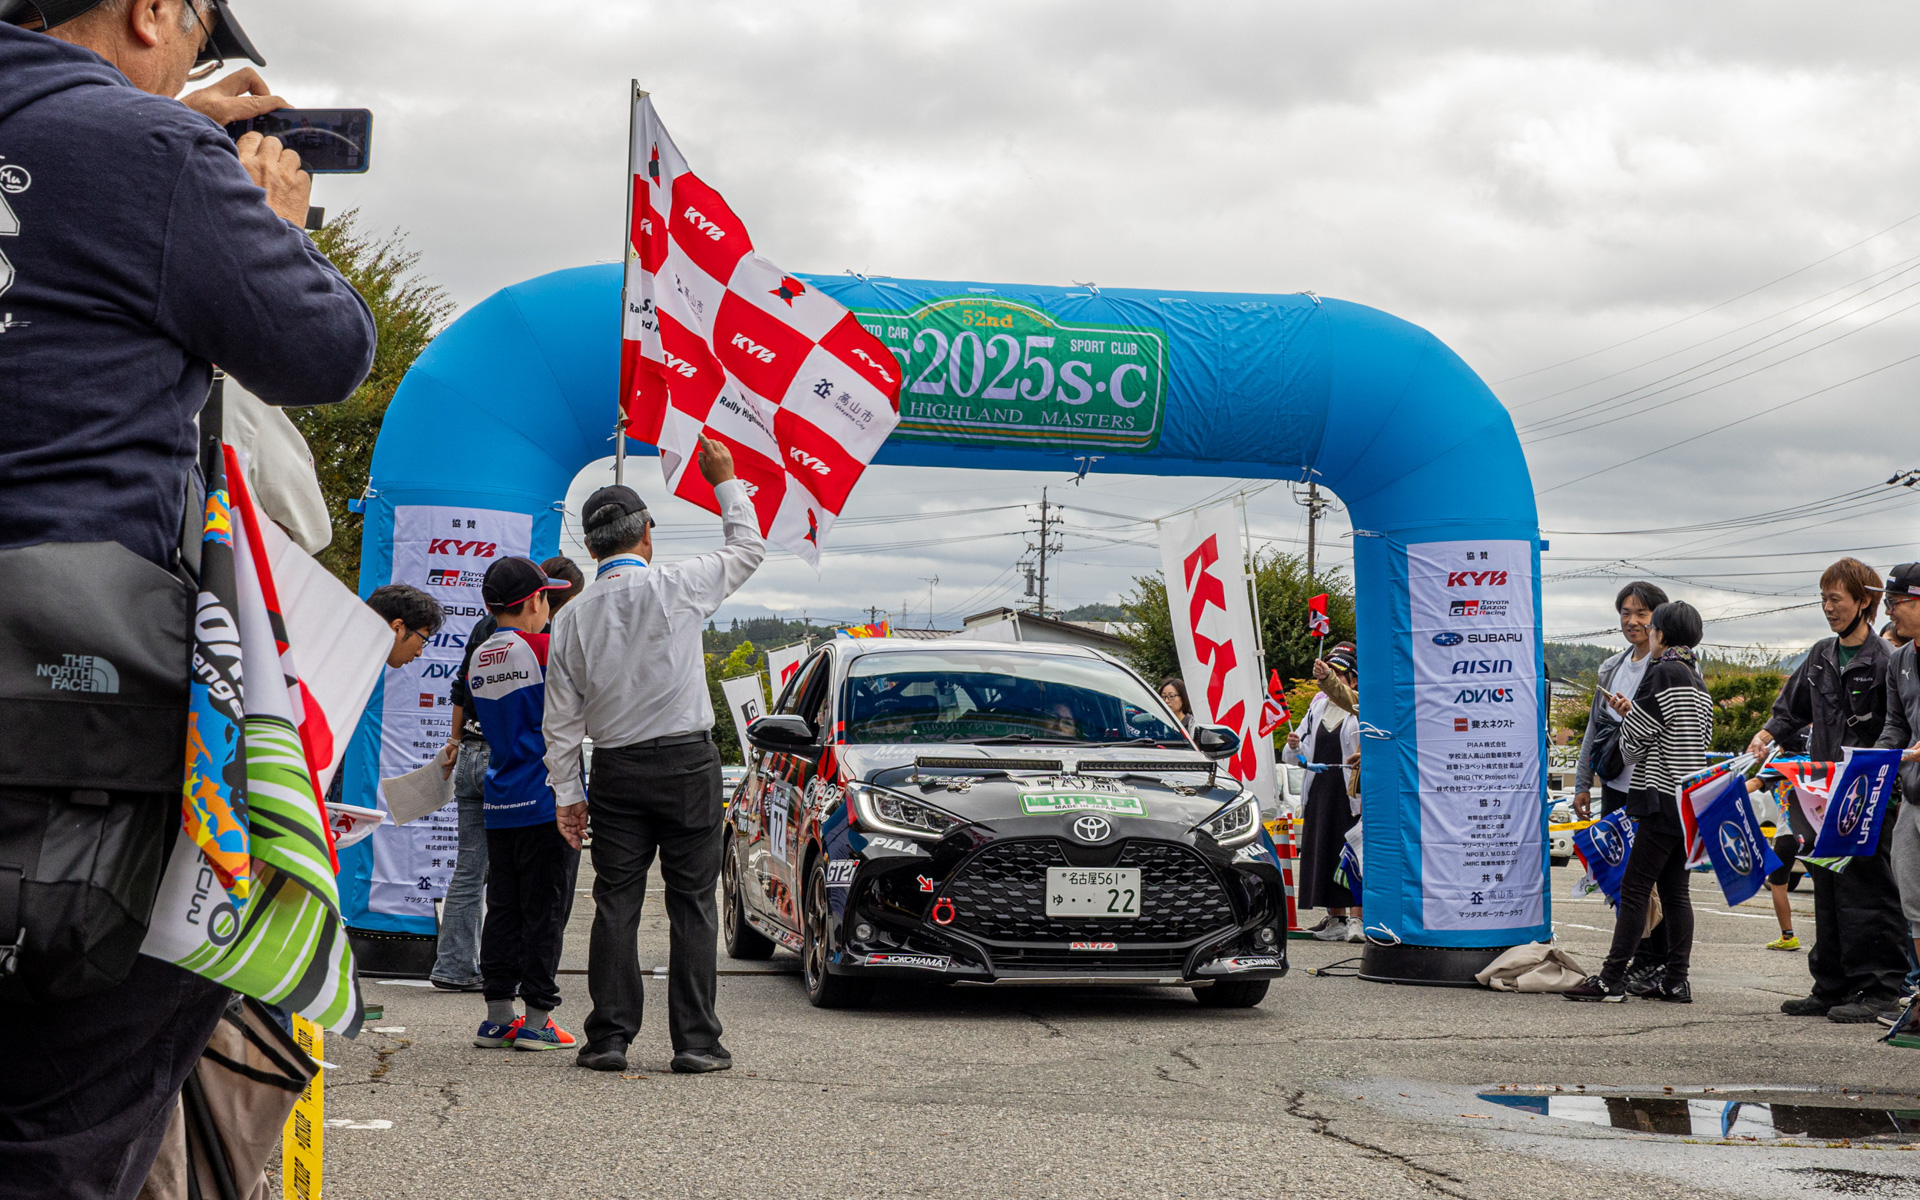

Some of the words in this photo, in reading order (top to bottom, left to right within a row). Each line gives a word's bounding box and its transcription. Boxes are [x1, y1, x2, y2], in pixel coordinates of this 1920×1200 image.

[683, 206, 725, 241] KYB
[962, 309, 1014, 328] 52nd
[731, 332, 776, 363] KYB
[888, 324, 909, 340] CAR
[1070, 339, 1106, 354] SPORT
[1111, 341, 1137, 356] CLUB
[719, 395, 741, 414] Rally
[837, 391, 874, 423] 高山市
[910, 402, 1023, 423] HIGHLAND
[1041, 411, 1135, 430] MASTERS
[789, 446, 831, 475] KYB
[427, 538, 497, 558] KYB
[427, 574, 458, 587] GR
[1447, 570, 1508, 587] KYB
[1449, 605, 1478, 617] GR
[1467, 633, 1523, 643] SUBARU
[62, 654, 92, 668] THE
[1452, 660, 1512, 674] AISIN
[37, 663, 92, 680] NORTH
[486, 670, 529, 684] SUBARU
[51, 677, 92, 692] FACE
[1453, 688, 1514, 704] ADVICS
[869, 837, 919, 855] PIAA
[1236, 843, 1269, 857] PIAA
[1052, 894, 1064, 907] ゆ
[1488, 889, 1514, 899] 高山市
[887, 955, 943, 967] YOKOHAMA
